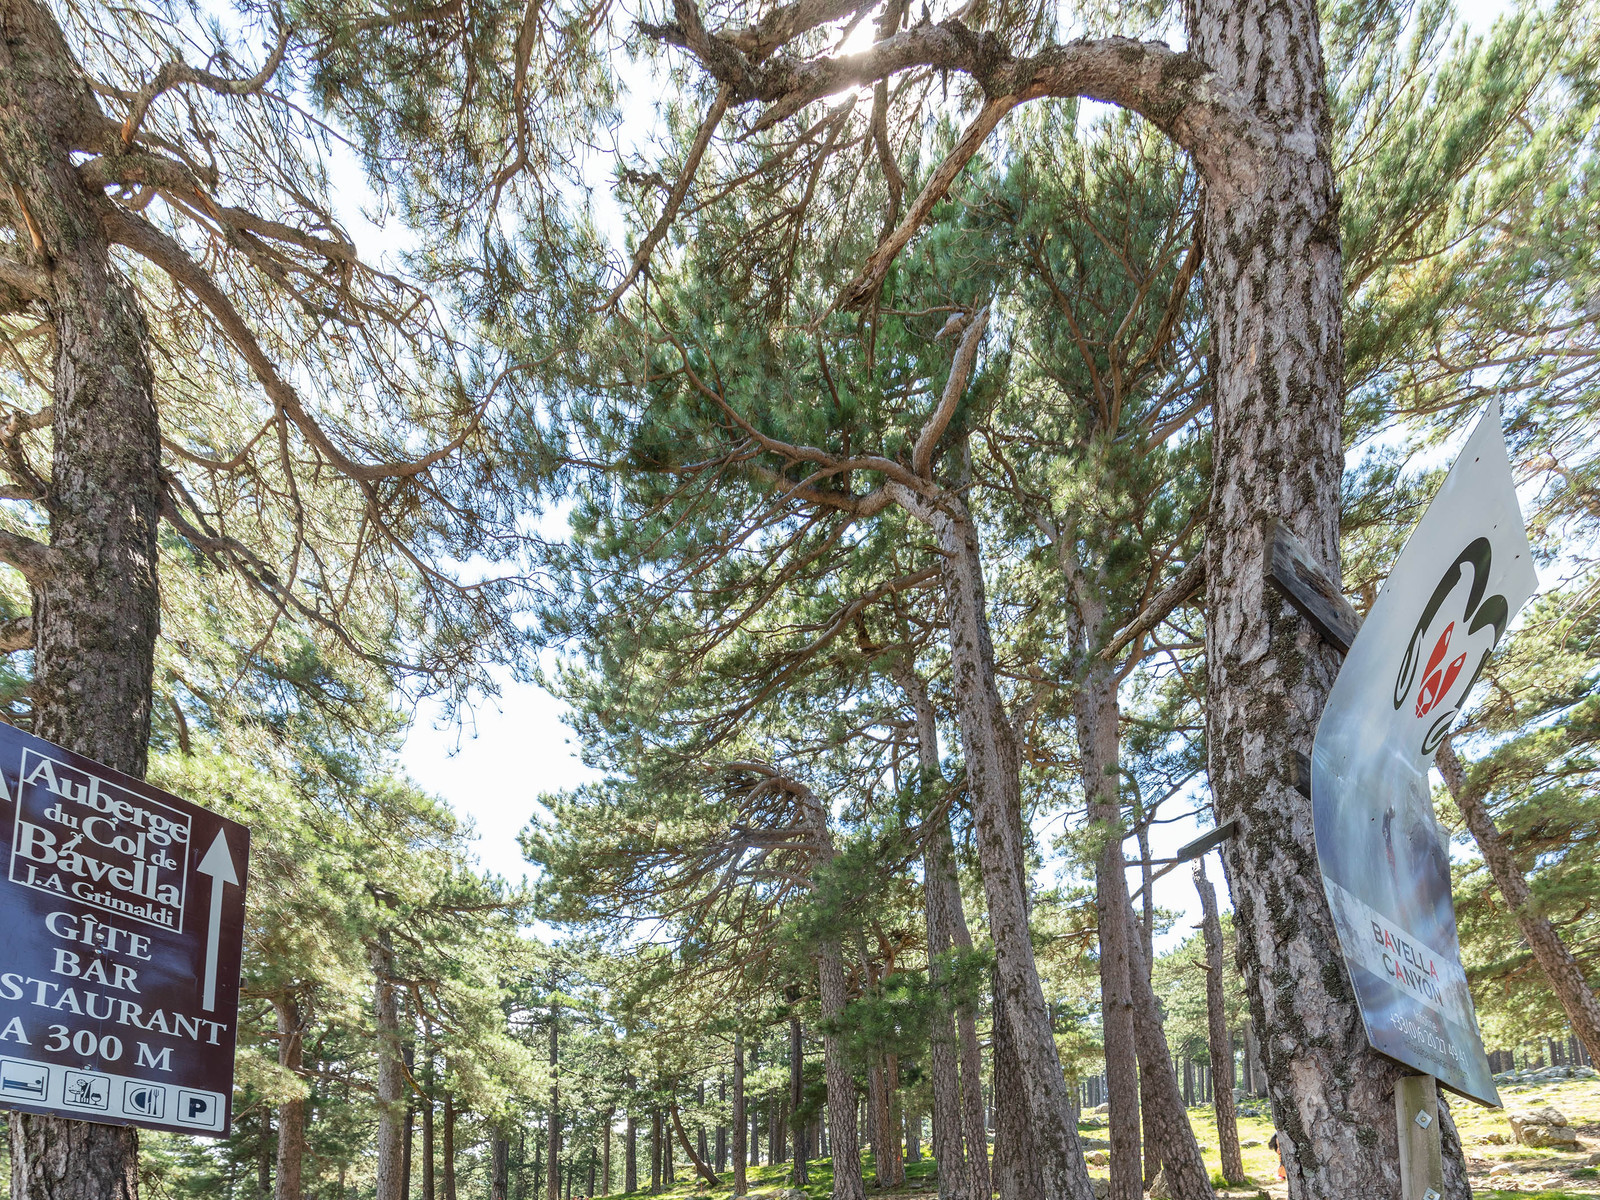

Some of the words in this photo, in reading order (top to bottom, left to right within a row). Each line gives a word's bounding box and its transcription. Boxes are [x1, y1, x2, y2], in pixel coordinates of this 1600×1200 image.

[23, 760, 188, 845] Auberge
[44, 803, 79, 830] du
[82, 816, 147, 861] Col
[151, 850, 177, 871] de
[71, 881, 174, 928] Grimaldi
[45, 911, 153, 961] GÎTE
[1371, 919, 1440, 983] BAVELLA
[50, 947, 142, 994] BAR
[1382, 952, 1445, 1008] CANYON
[0, 1016, 32, 1046] A
[44, 1024, 124, 1062] 300
[134, 1041, 174, 1072] M
